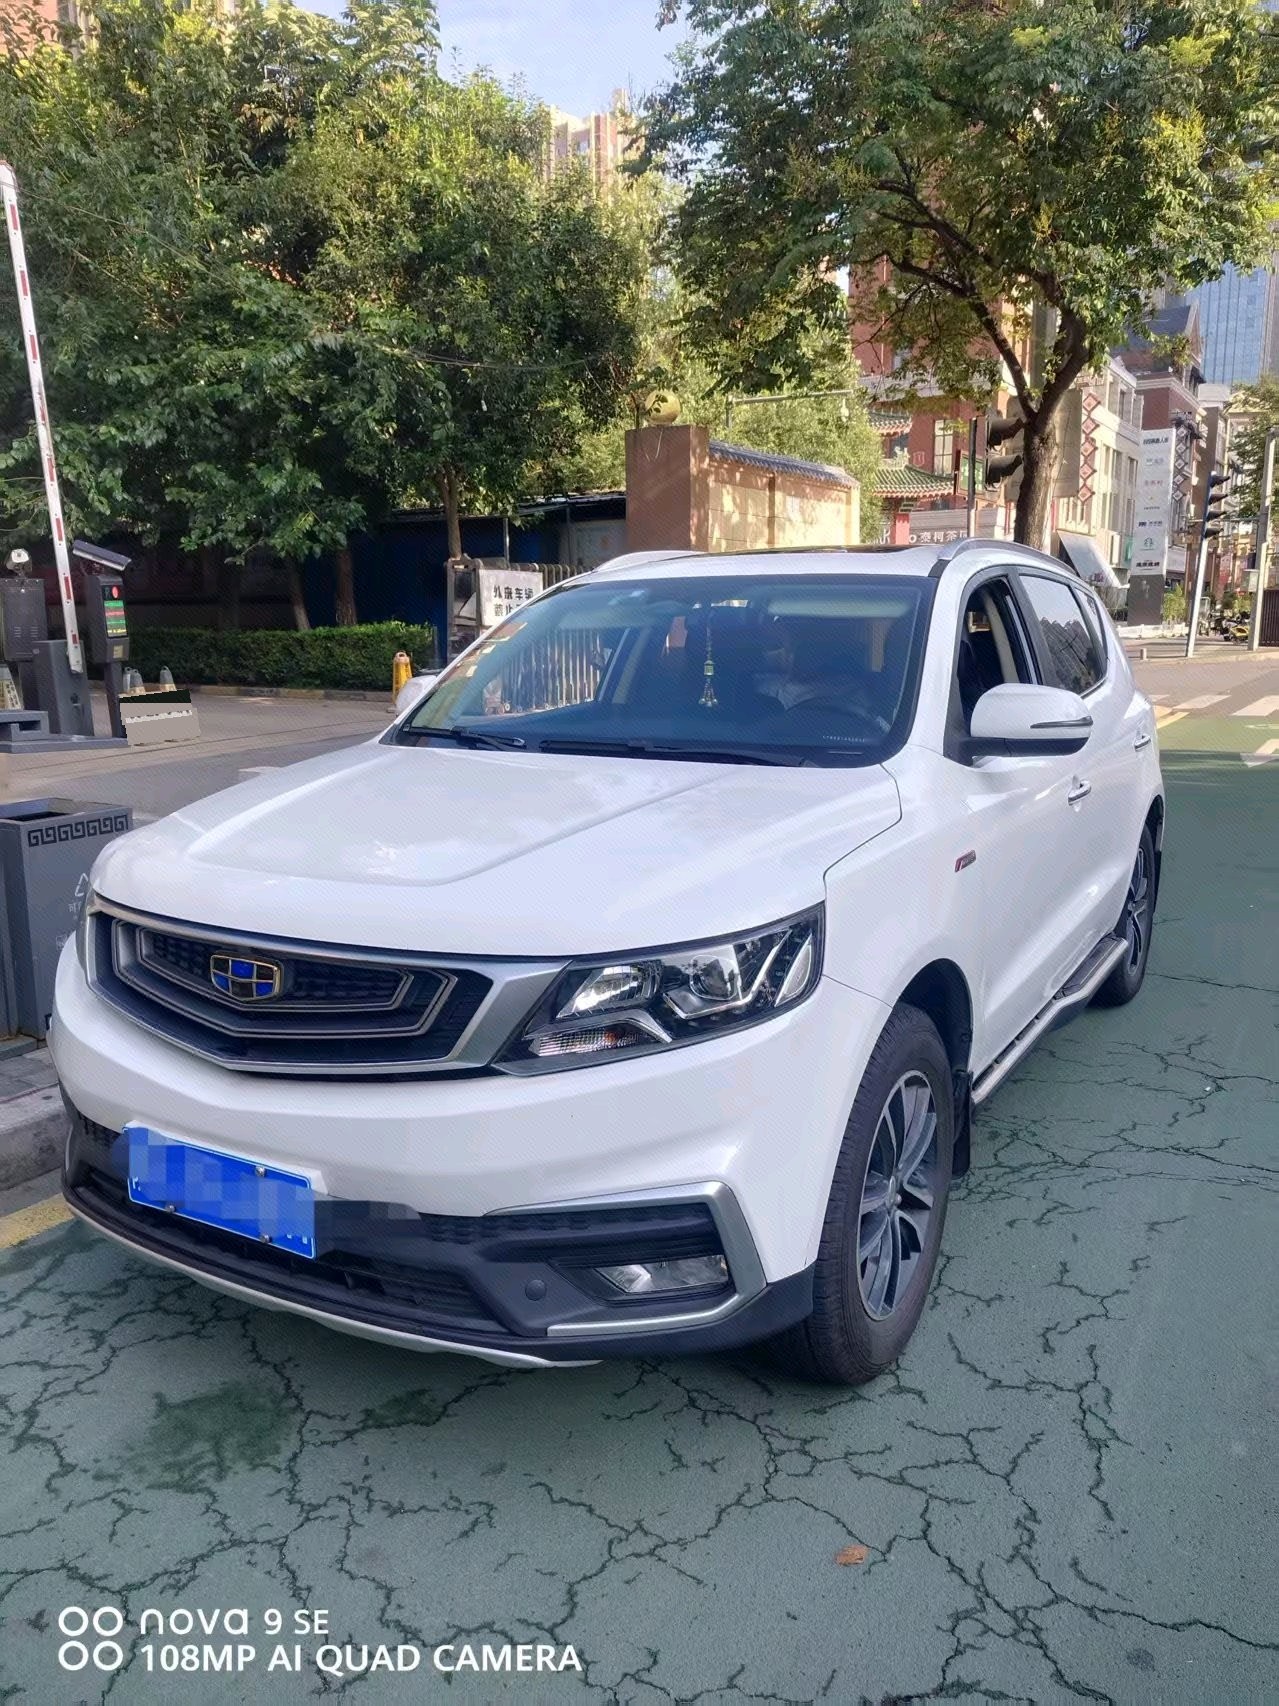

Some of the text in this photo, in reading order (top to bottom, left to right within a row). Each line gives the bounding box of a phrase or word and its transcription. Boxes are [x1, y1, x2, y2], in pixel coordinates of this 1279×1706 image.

[493, 585, 534, 601] 外来车辆
[494, 603, 523, 617] 禁止
